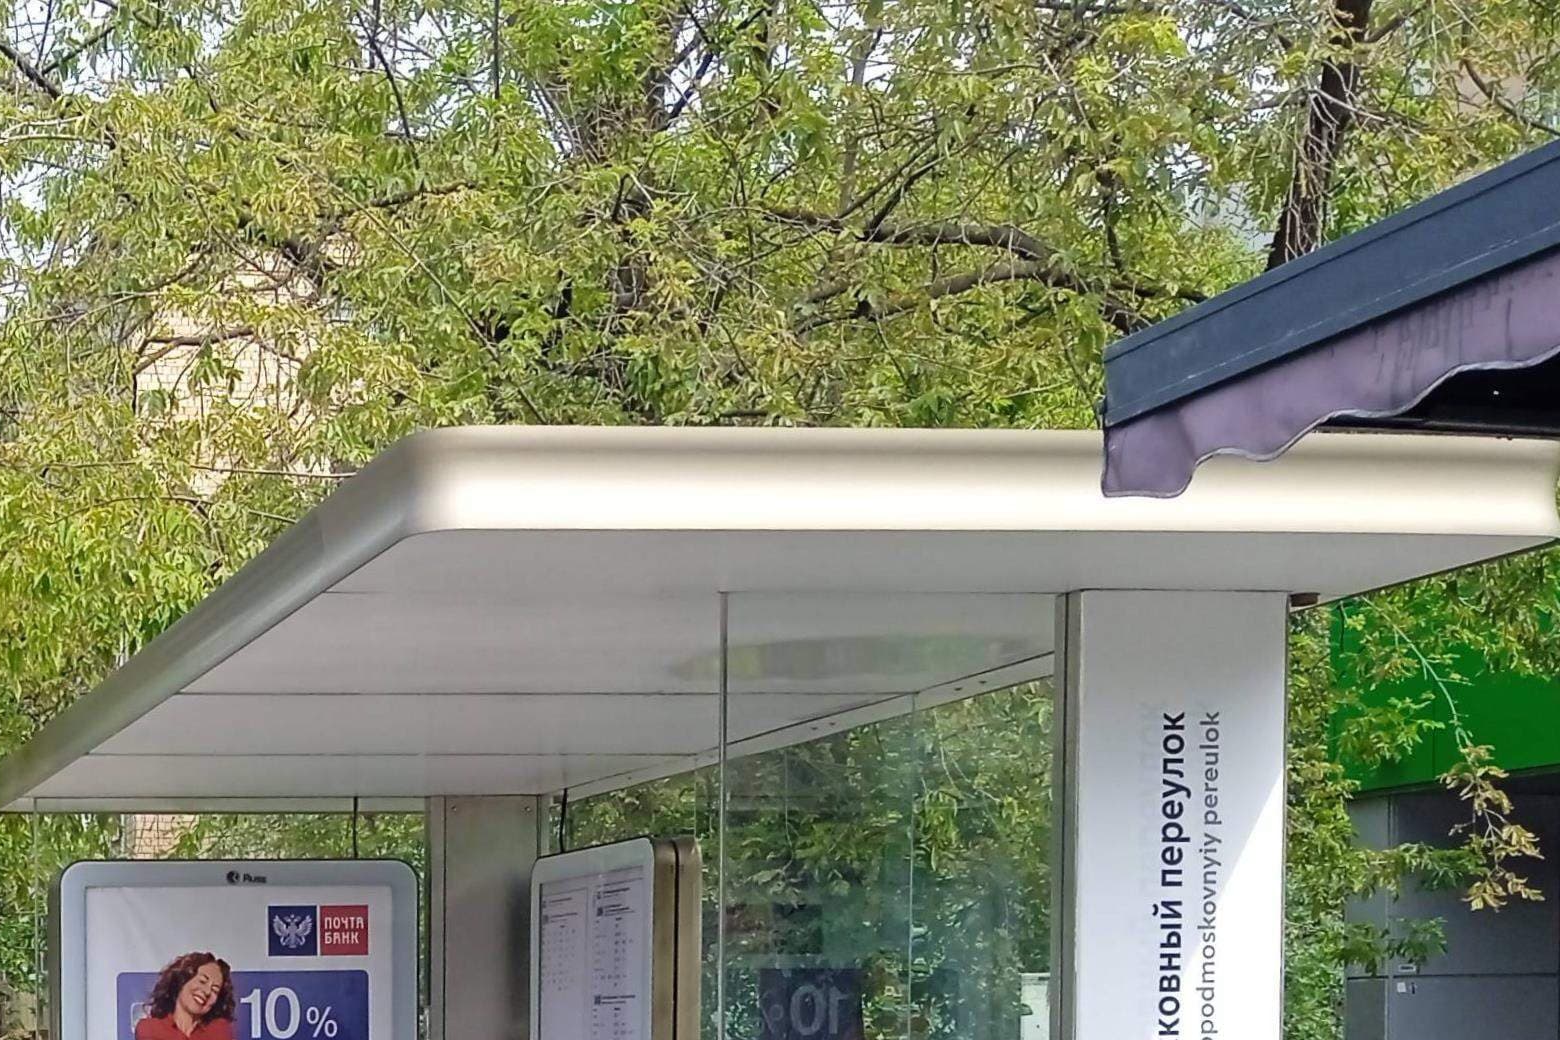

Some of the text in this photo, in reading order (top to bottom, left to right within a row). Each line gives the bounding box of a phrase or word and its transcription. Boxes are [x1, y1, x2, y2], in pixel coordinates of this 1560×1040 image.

[1161, 712, 1191, 887] переулок
[1199, 712, 1222, 825] pereulok
[324, 916, 364, 930] ПОЧТА
[324, 932, 359, 944] БАНК
